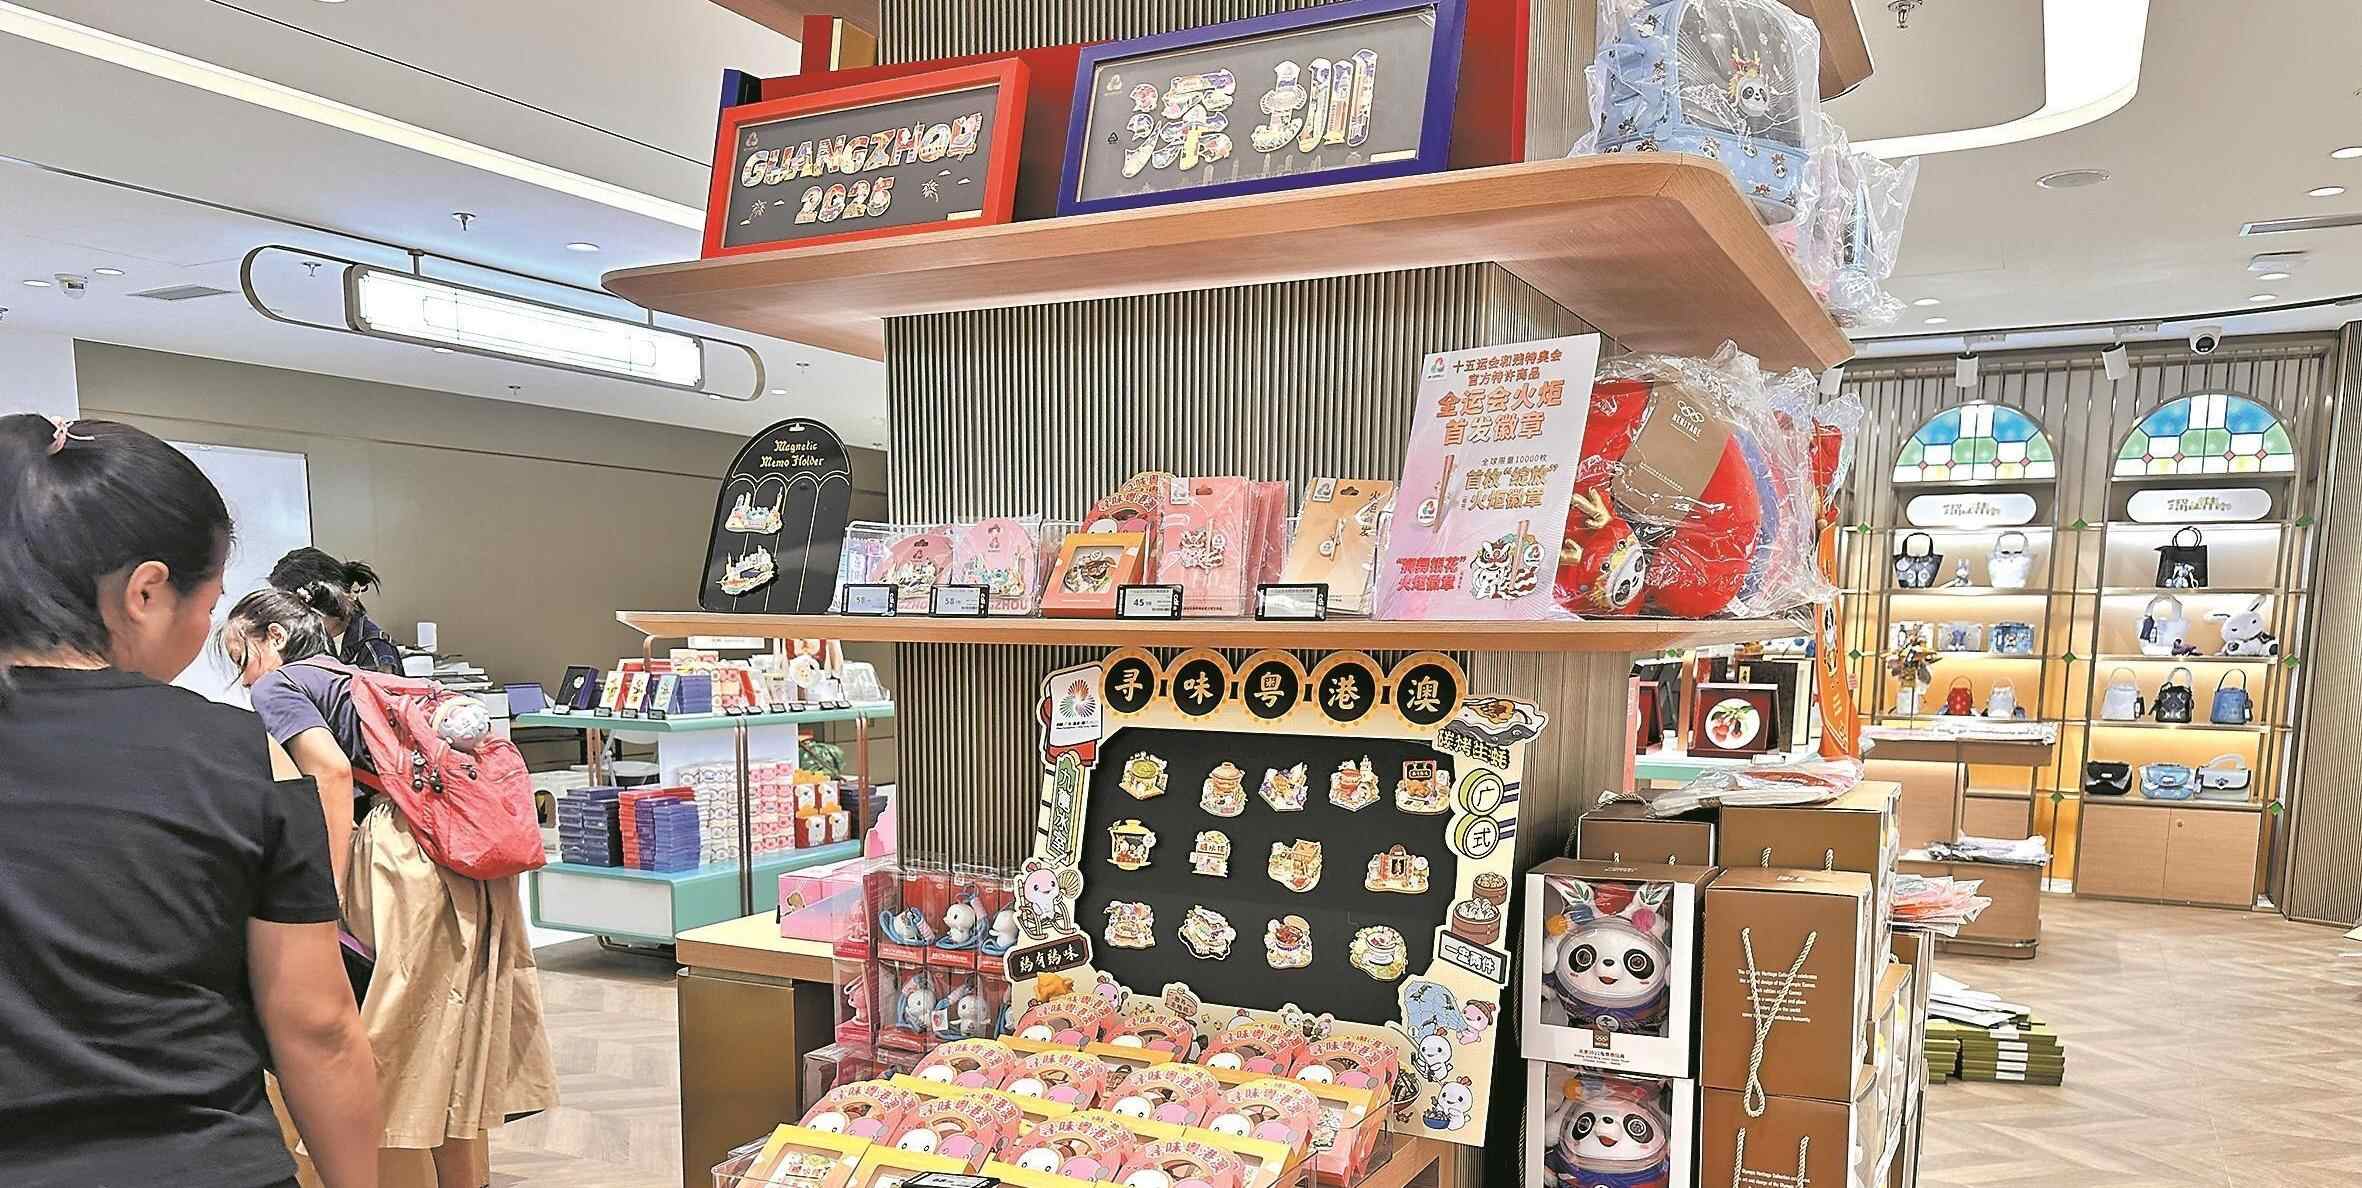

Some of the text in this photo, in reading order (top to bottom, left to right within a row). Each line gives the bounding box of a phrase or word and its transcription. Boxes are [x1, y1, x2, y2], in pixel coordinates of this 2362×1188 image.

[1121, 48, 1378, 179] 深圳
[741, 112, 983, 188] GUANGZHOU
[794, 176, 895, 225] 2025
[1453, 348, 1563, 374] 十五运会和残特奥会
[1468, 366, 1541, 387] 官方特许商品
[1436, 379, 1565, 418] 全运会火炬
[1443, 411, 1545, 446] 首发徽章
[1671, 413, 1702, 439] HERITAGE
[774, 440, 818, 453] Magnetic
[760, 454, 825, 468] Memo Holder
[1468, 488, 1544, 511] 火炬徽章
[1133, 598, 1145, 607] 45
[1114, 668, 1441, 713] 寻味粤港澳
[1445, 944, 1495, 975] 一盅两件
